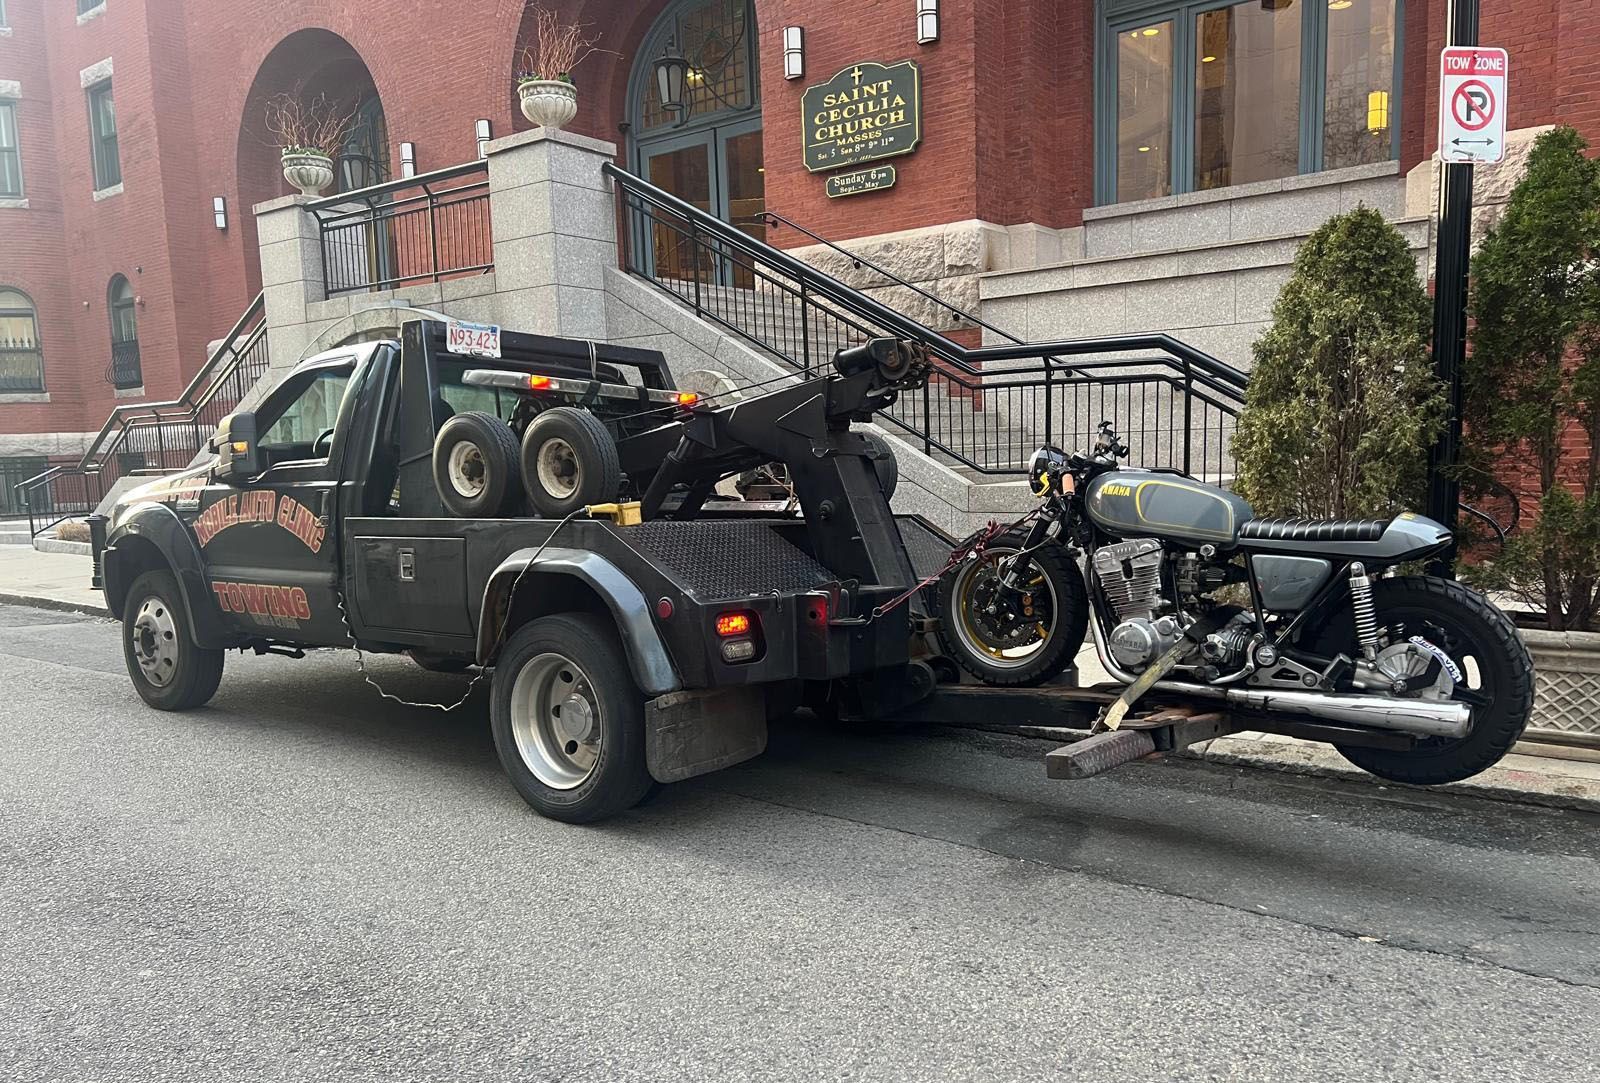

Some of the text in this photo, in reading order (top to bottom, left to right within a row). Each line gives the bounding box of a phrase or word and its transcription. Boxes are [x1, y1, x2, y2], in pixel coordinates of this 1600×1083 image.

[1446, 56, 1503, 71] TOW ZONE
[823, 79, 893, 108] SAINT
[814, 94, 906, 125] CECILIA
[815, 109, 906, 141] CHURCH
[836, 129, 883, 147] MASSES
[834, 173, 866, 187] Sunday
[865, 181, 880, 190] May
[193, 494, 238, 549] MOBILE
[240, 490, 276, 524] AUTO
[277, 495, 327, 554] CLINIC
[212, 581, 312, 620] TOWING
